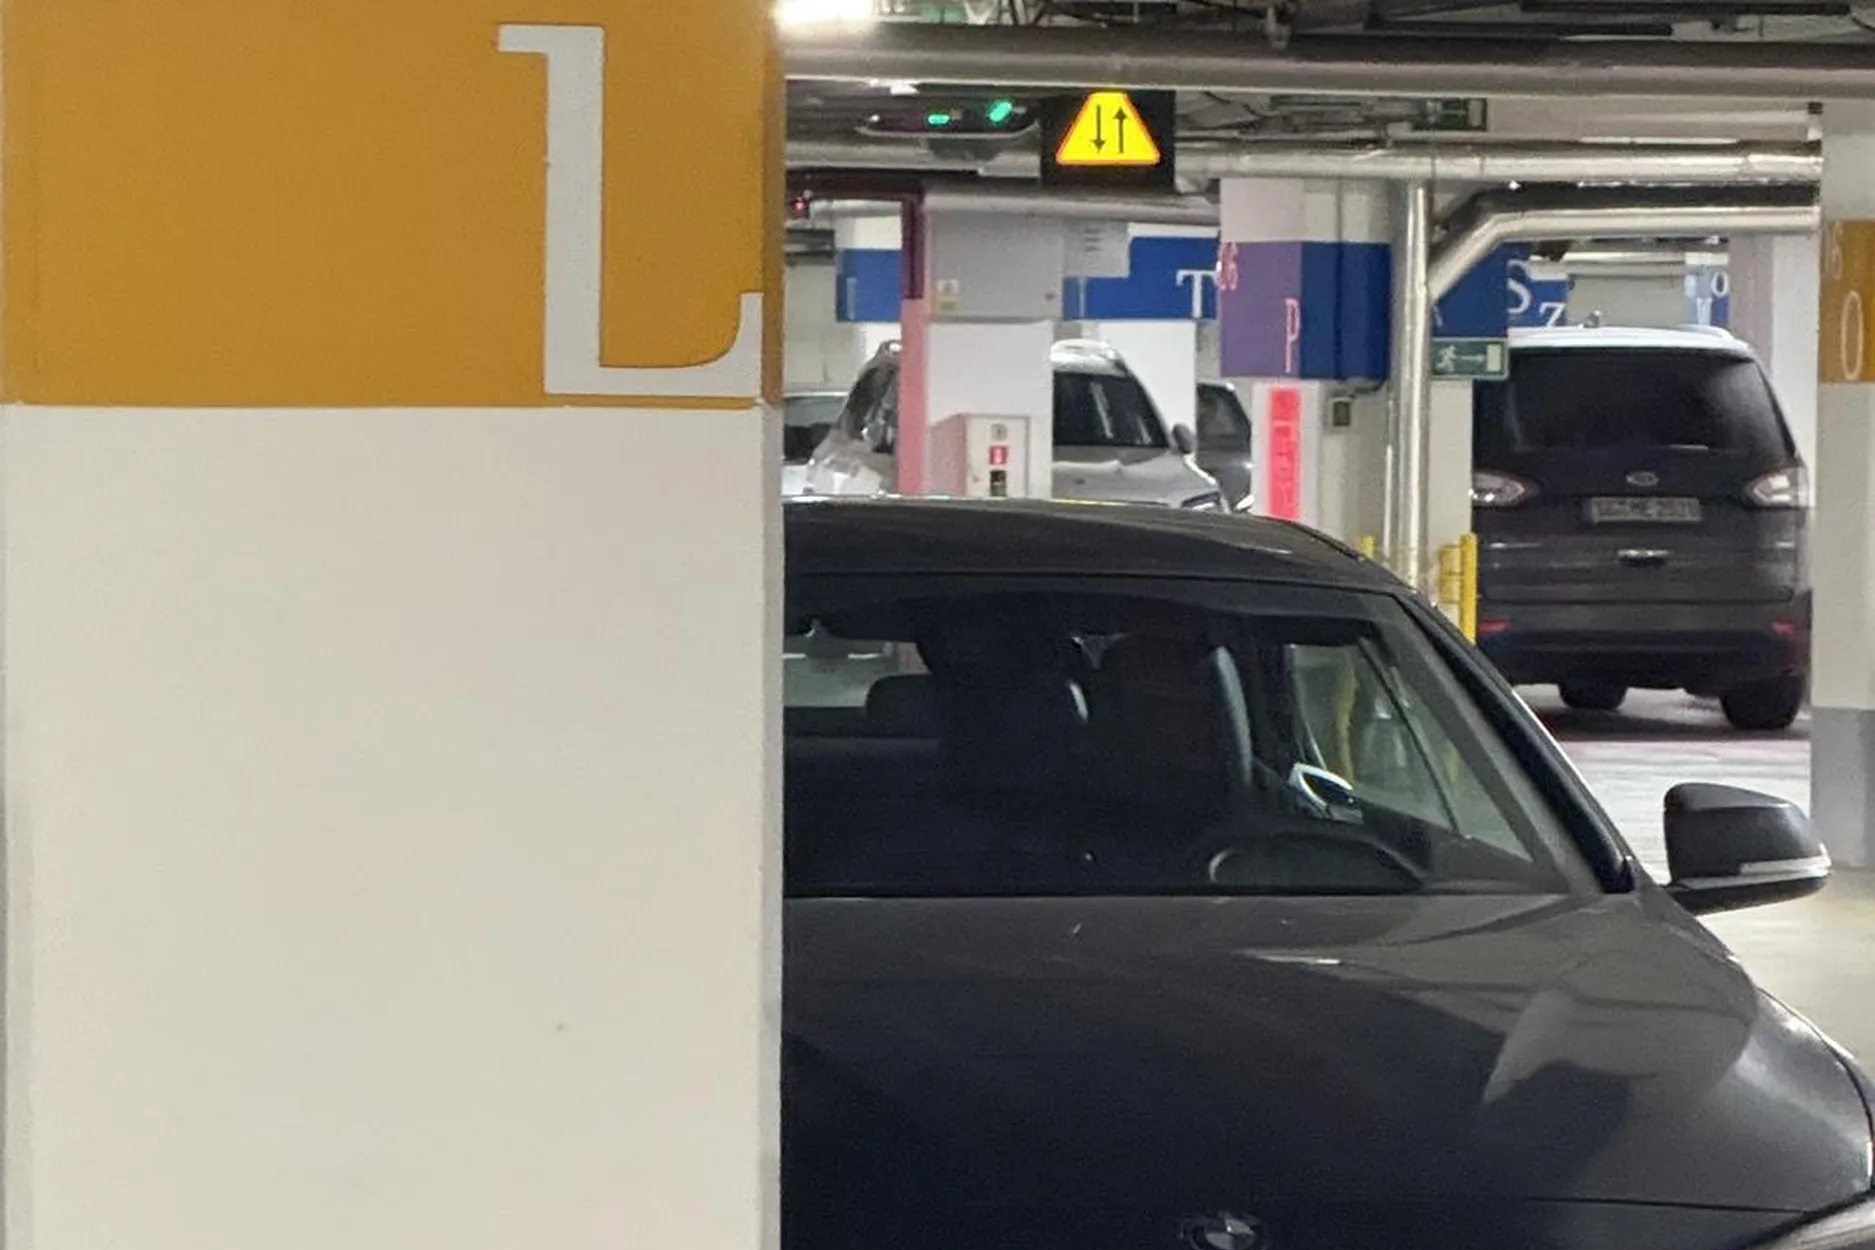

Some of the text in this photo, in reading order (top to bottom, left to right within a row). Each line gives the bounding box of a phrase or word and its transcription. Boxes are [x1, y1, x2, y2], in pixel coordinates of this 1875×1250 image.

[497, 24, 763, 398] L
[1175, 269, 1221, 318] T
[1285, 298, 1300, 373] P
